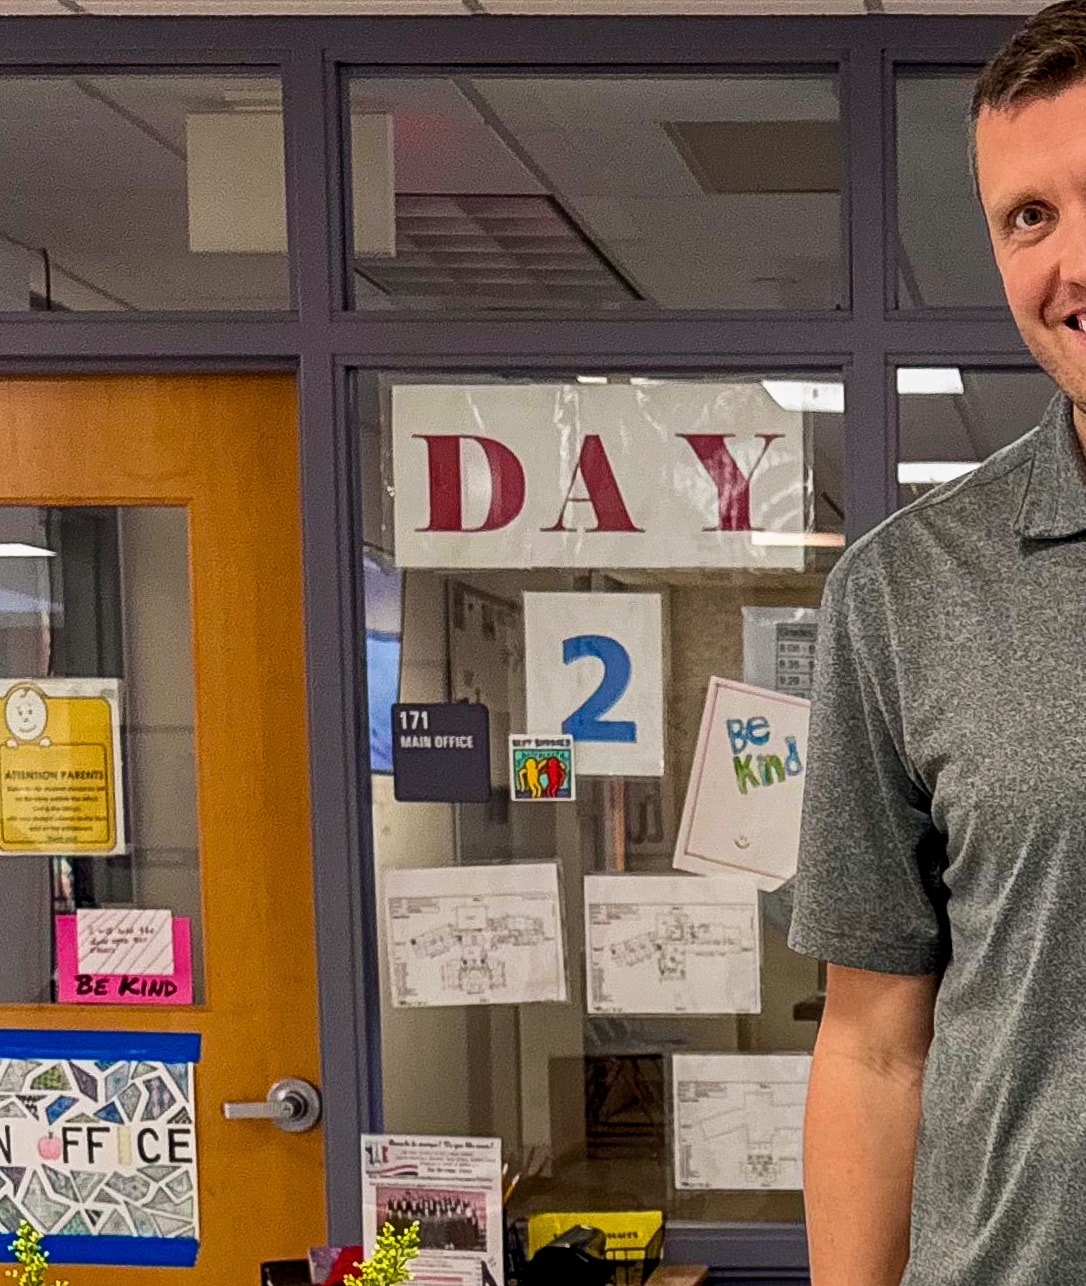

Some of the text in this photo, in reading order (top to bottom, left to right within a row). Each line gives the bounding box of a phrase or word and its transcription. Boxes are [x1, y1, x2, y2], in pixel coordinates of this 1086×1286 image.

[412, 433, 787, 533] DAY
[561, 634, 638, 743] 2
[400, 710, 428, 730] 171
[400, 735, 474, 749] MAIN OFFICE
[75, 974, 178, 997] BE KIND
